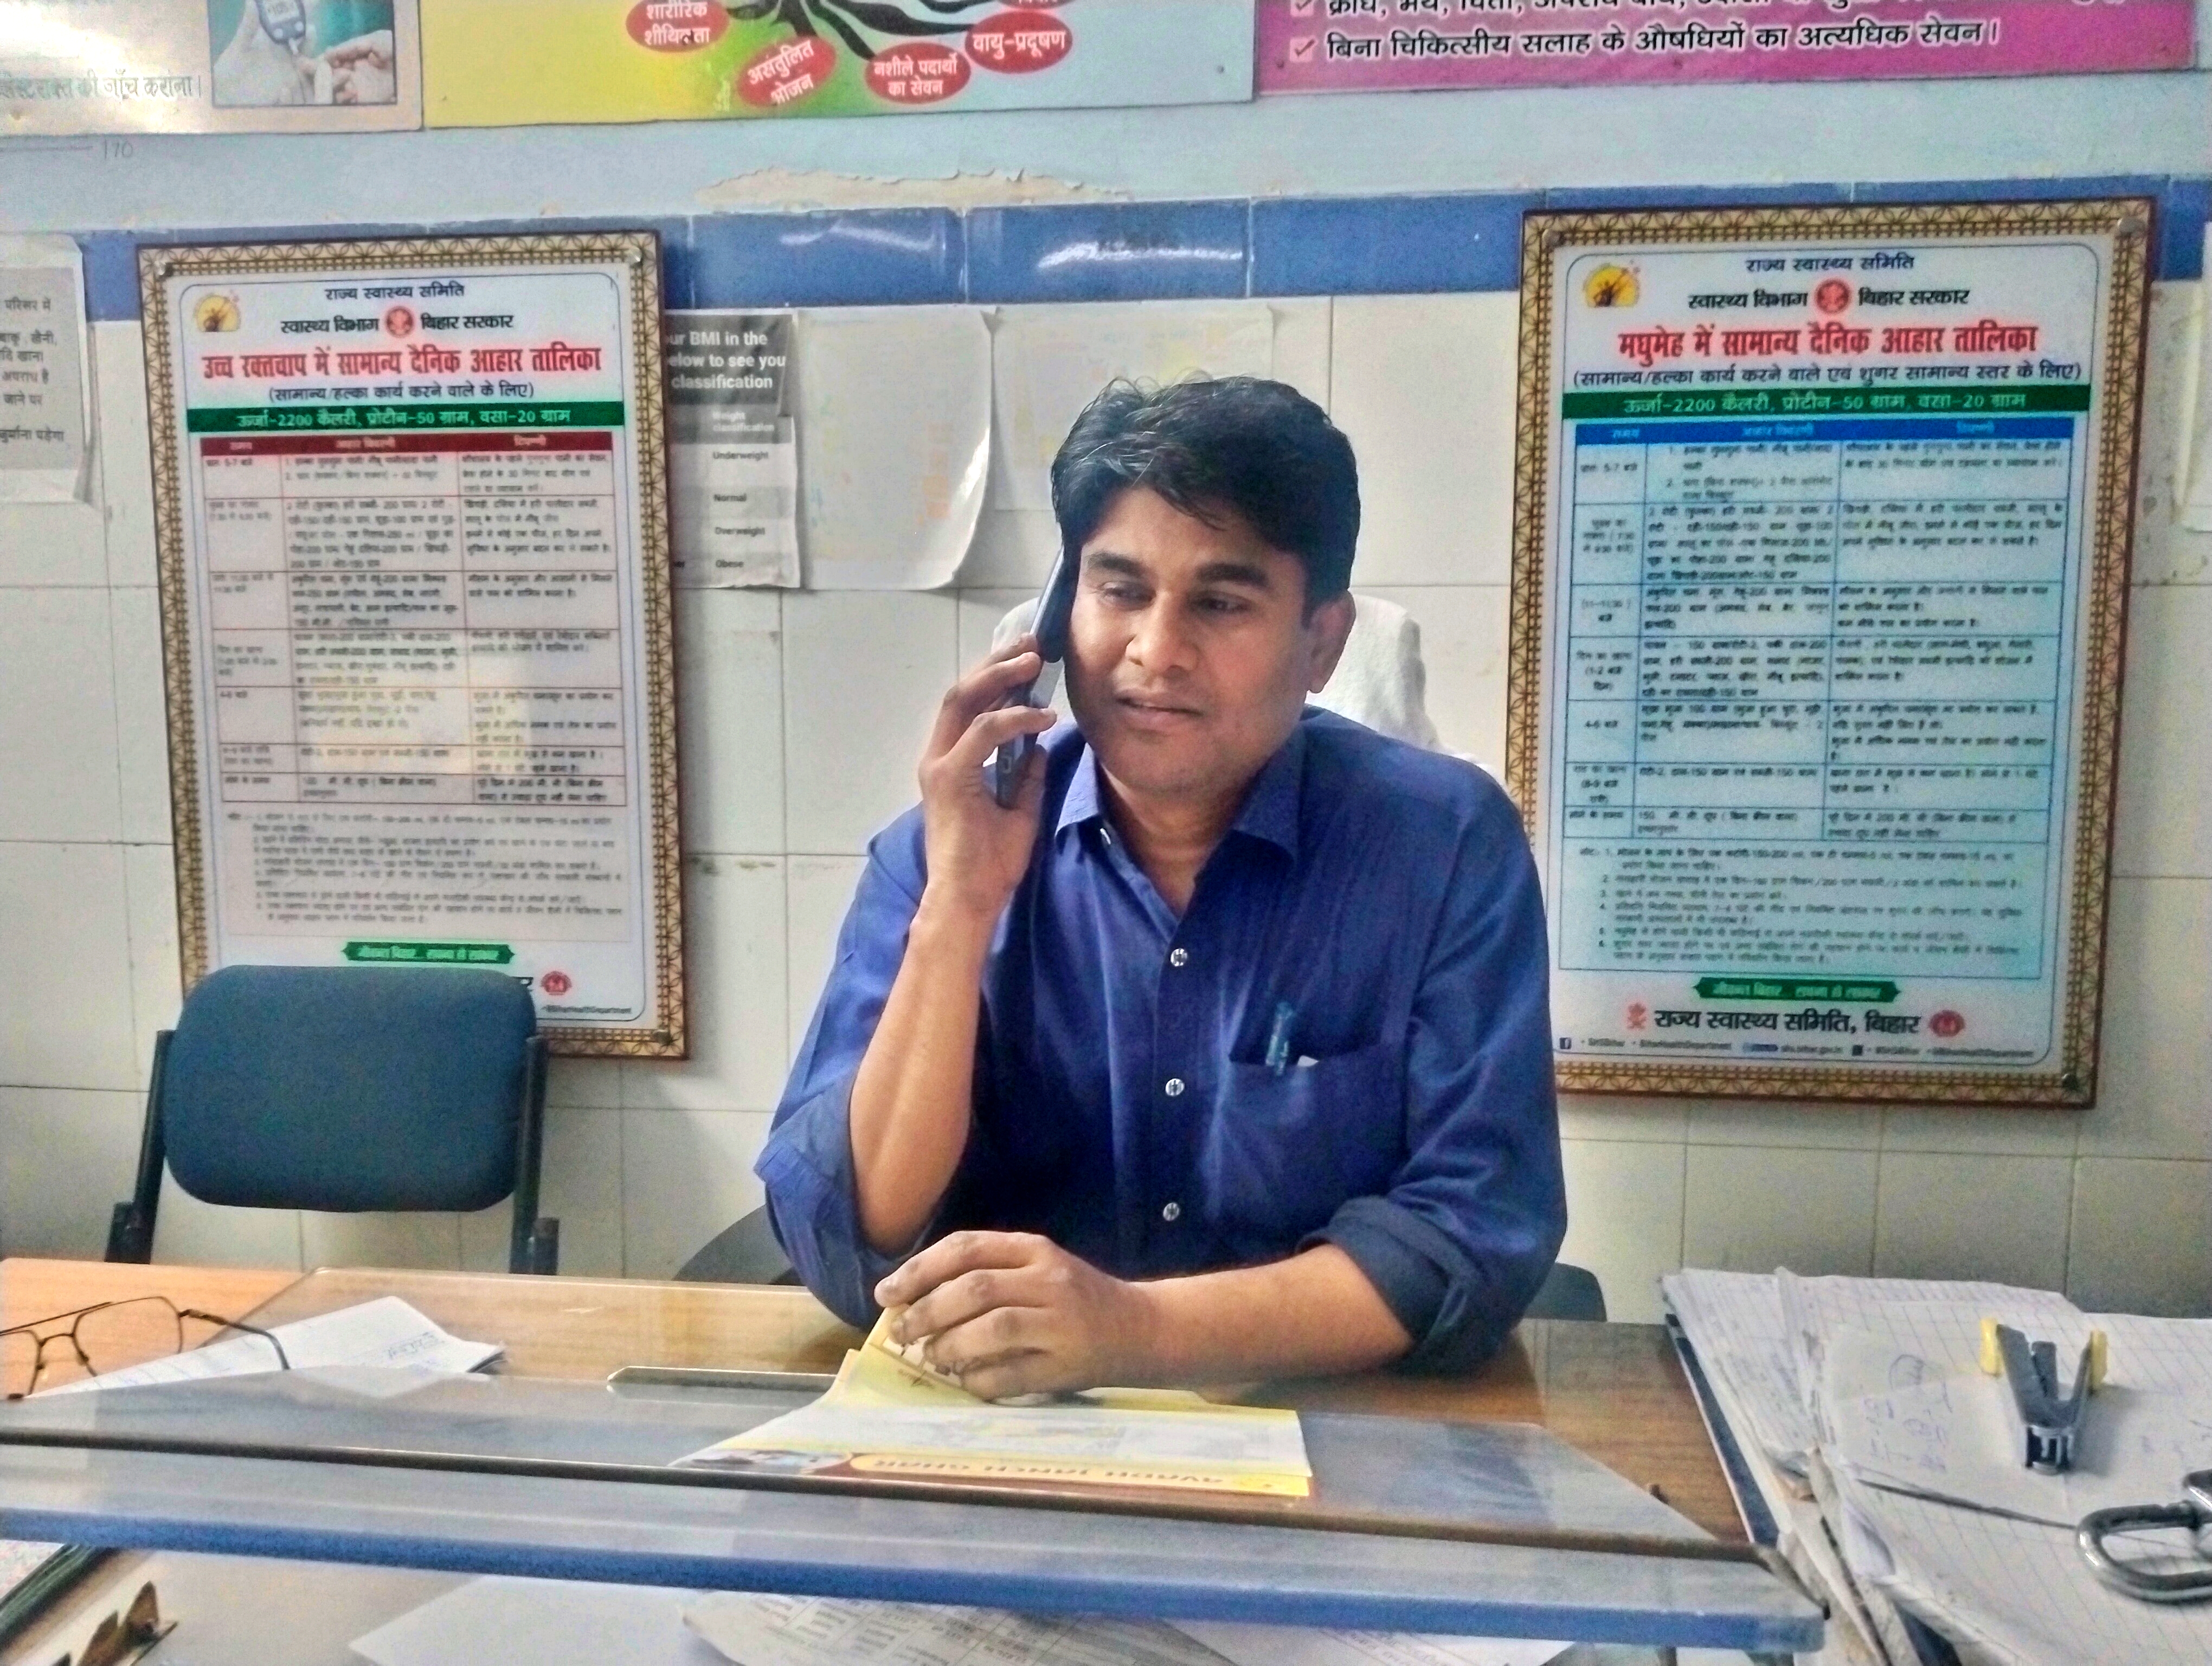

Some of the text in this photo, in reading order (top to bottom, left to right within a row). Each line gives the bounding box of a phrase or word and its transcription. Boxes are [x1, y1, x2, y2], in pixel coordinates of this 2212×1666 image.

[973, 30, 1066, 60] वायु-प्रदूषण
[1327, 33, 1382, 59] बिना
[1391, 28, 1511, 57] चिकित्सीय
[1521, 34, 1590, 53] सलाह
[1601, 24, 1626, 50] के
[1636, 22, 1744, 50] औषधियों
[1756, 28, 1787, 47] का
[1799, 18, 1911, 46] अत्यधिक
[873, 55, 914, 77] नशीले
[888, 75, 944, 97] का सेवन
[1745, 259, 1785, 272] राज्य
[325, 287, 358, 300] राज्य
[1857, 286, 1905, 306] बिहार
[1908, 287, 1971, 306] सरकार
[420, 312, 460, 331] बिहार
[462, 315, 515, 330] सरकार
[668, 331, 768, 345] ur BMI in the
[1693, 323, 1715, 357] में
[1721, 330, 1802, 356] सामान्य
[1808, 321, 1873, 355] दैनिक
[1880, 327, 1946, 354] आहार
[1952, 319, 2039, 353] तालिका
[314, 346, 332, 376] में
[336, 351, 403, 375] सामान्य
[407, 344, 462, 374] दैनिक
[470, 349, 523, 373] आहार
[529, 341, 602, 372] तालिका
[709, 354, 724, 367] to
[729, 356, 755, 367] see
[1700, 363, 1736, 383] कार्य
[1741, 364, 1782, 383] करने
[1788, 363, 1821, 382] वाले
[1906, 365, 1970, 380] सामान्य
[2016, 360, 2033, 379] के
[2039, 358, 2082, 381] लिए)
[373, 380, 403, 398] कार्य
[408, 380, 442, 398] करने
[447, 380, 475, 398] वाले
[480, 380, 494, 396] के
[499, 379, 535, 399] लिए)
[671, 374, 773, 389] classification
[713, 451, 769, 460] Underweight
[714, 494, 747, 502] Normal
[715, 526, 766, 537] Overweight
[716, 559, 744, 567] Obese
[1655, 1009, 1702, 1028] राज्य
[1863, 1009, 1923, 1035] बिहार
